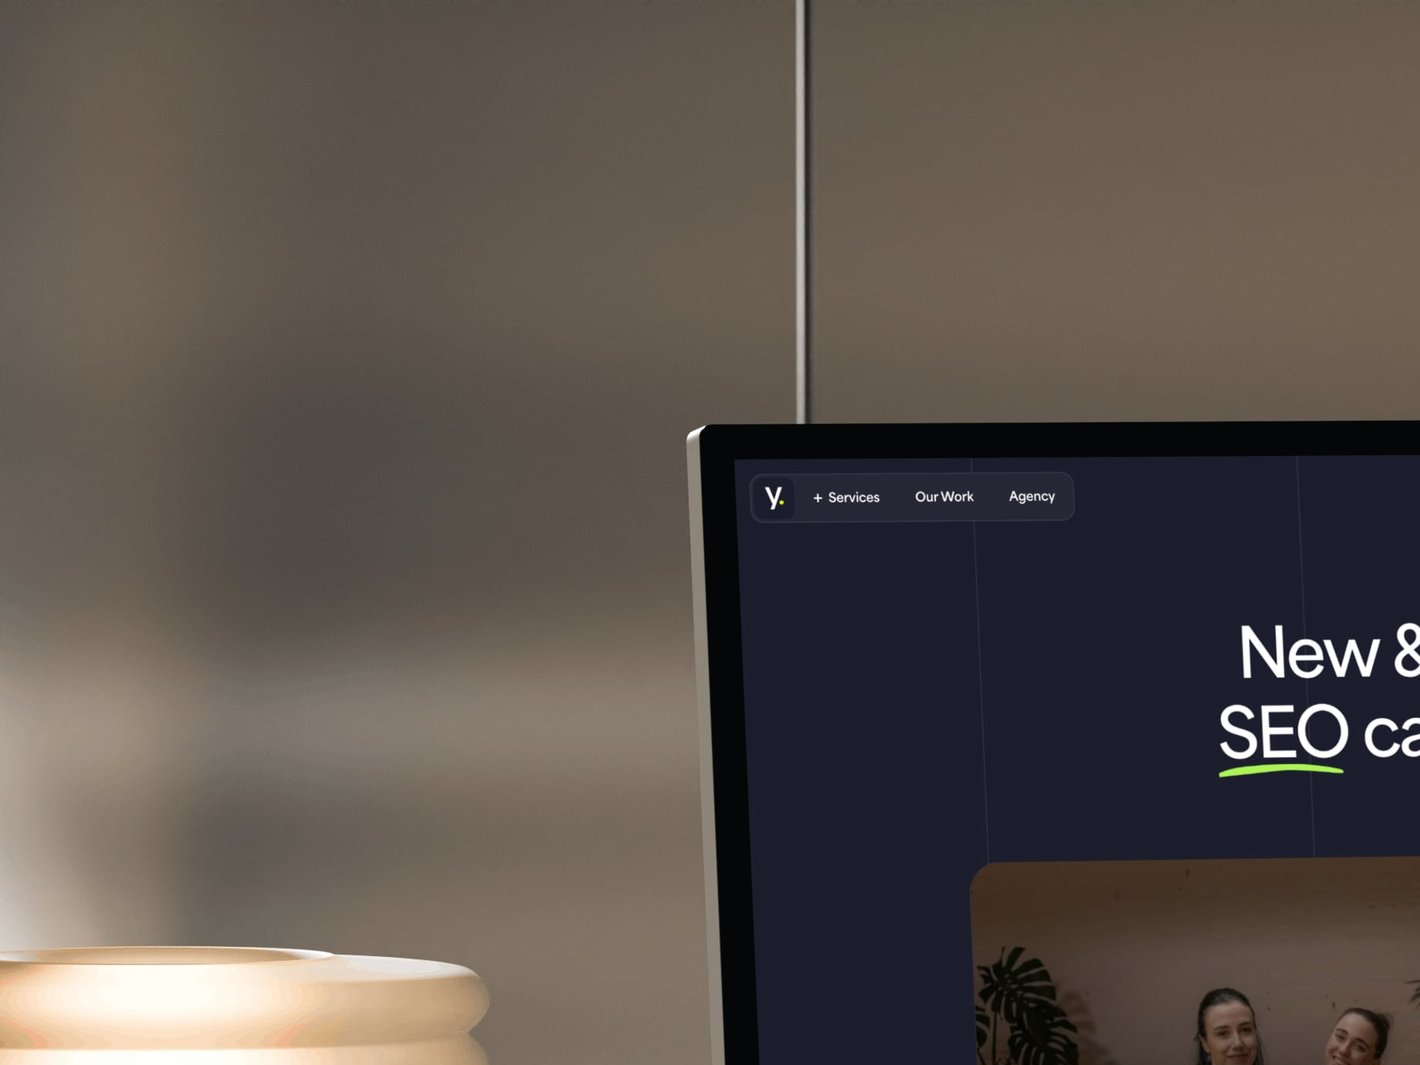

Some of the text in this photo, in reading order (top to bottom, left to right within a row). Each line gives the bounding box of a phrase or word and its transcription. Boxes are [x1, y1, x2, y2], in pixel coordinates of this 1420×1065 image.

[828, 491, 881, 504] Services
[915, 490, 975, 503] Our Work
[1008, 490, 1056, 505] Agency
[1242, 625, 1380, 678] New
[1220, 704, 1348, 759] SEO
